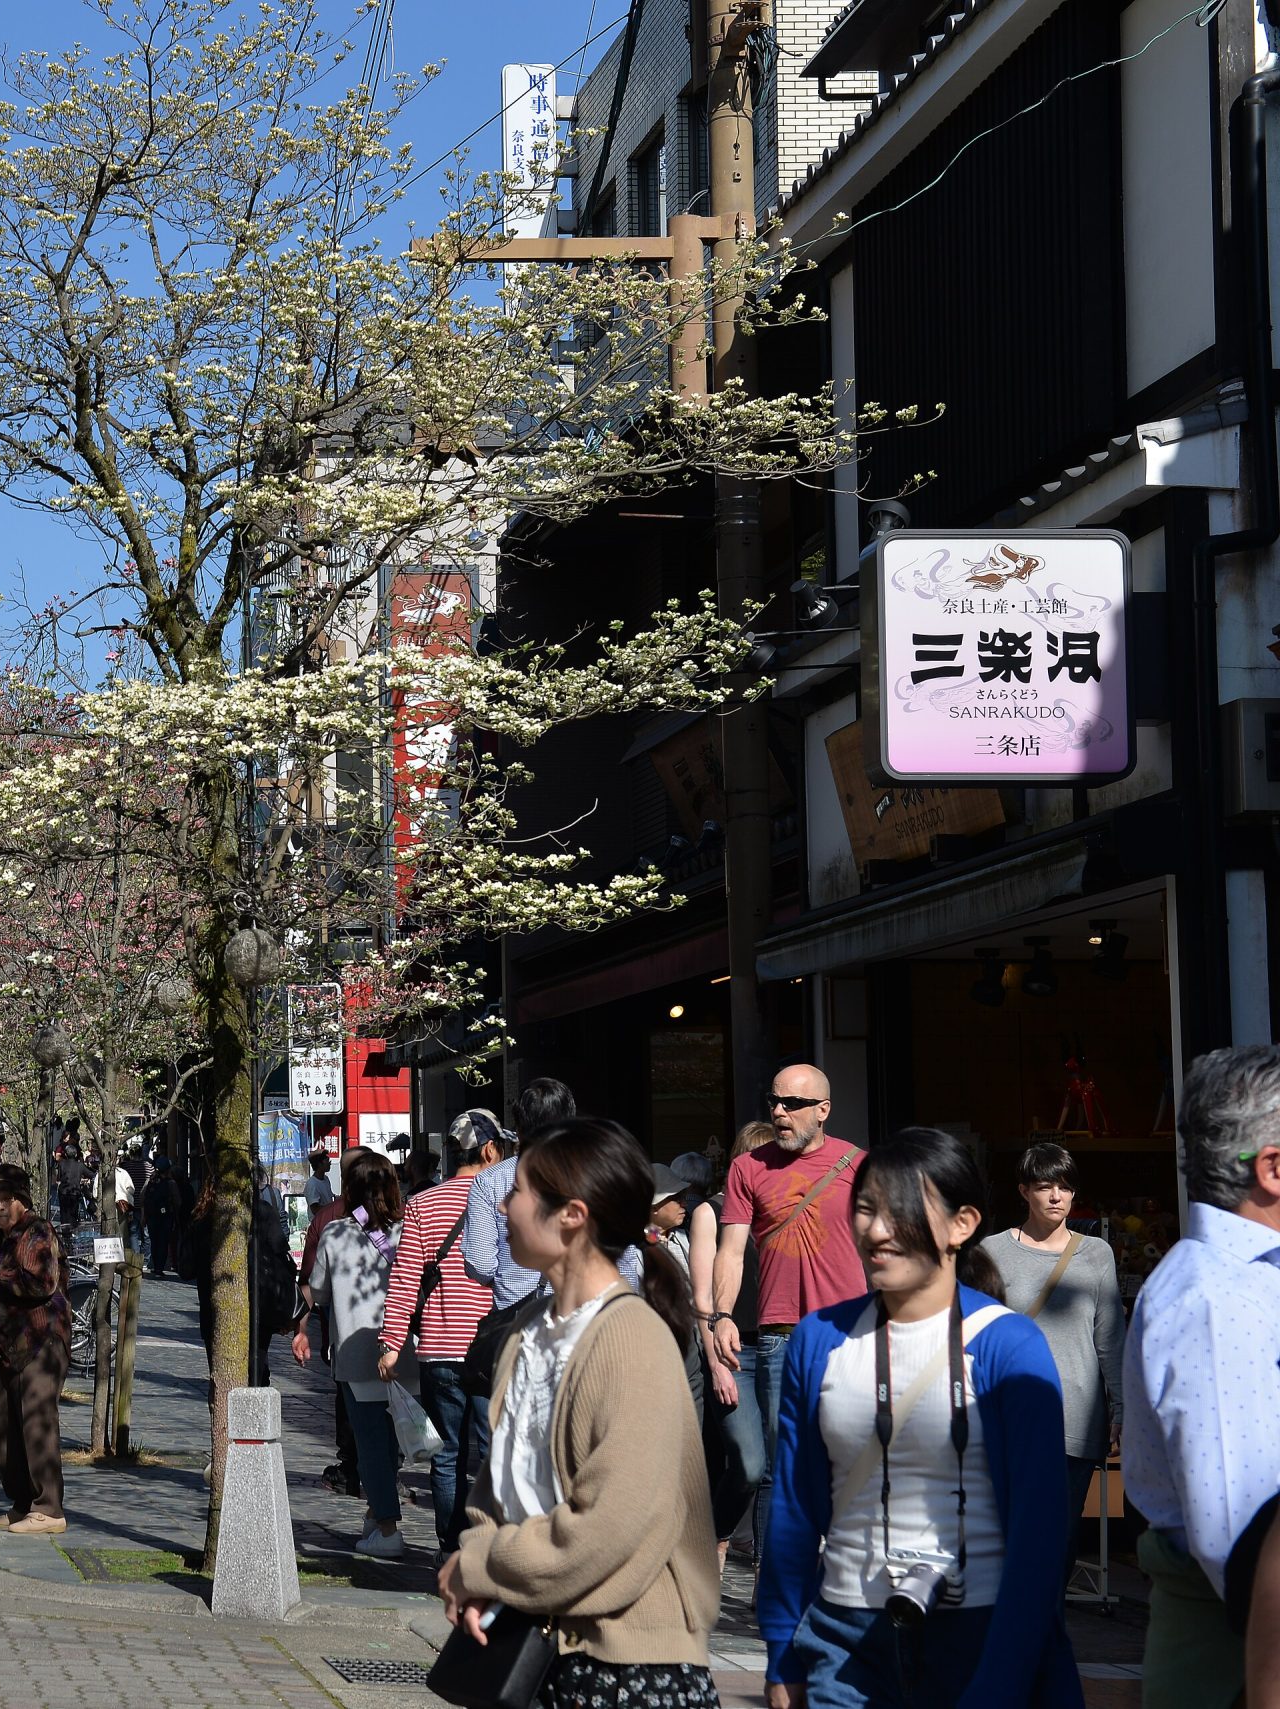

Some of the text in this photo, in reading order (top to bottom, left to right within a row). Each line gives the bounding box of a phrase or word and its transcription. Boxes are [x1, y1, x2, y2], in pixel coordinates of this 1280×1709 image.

[942, 599, 1068, 614] 奈良土産・工芸館
[976, 689, 1038, 700] さんらくどう
[949, 706, 1065, 719] SANRAKUDO
[974, 735, 1041, 756] 三条店
